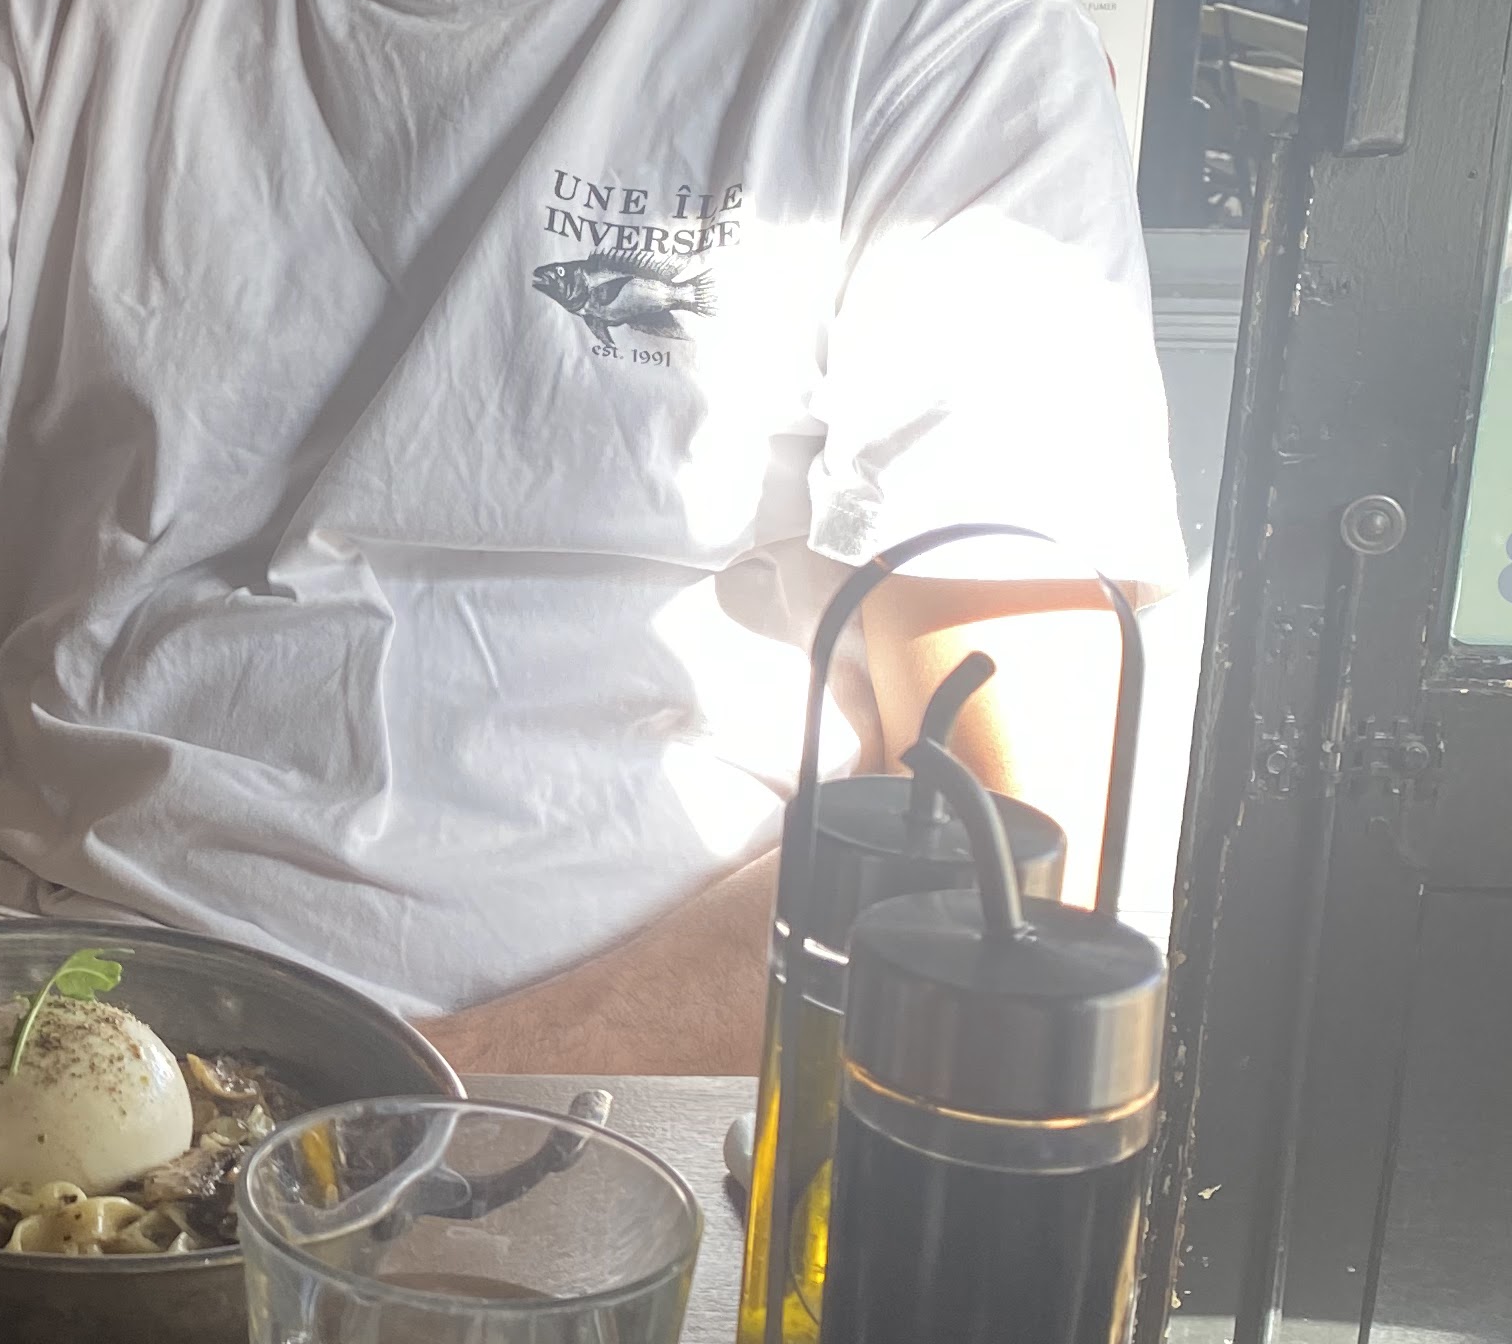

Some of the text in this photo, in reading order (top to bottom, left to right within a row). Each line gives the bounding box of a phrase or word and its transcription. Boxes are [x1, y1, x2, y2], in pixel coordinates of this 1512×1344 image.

[554, 169, 743, 220] UNE ÎLE
[591, 344, 671, 367] est. 1991
